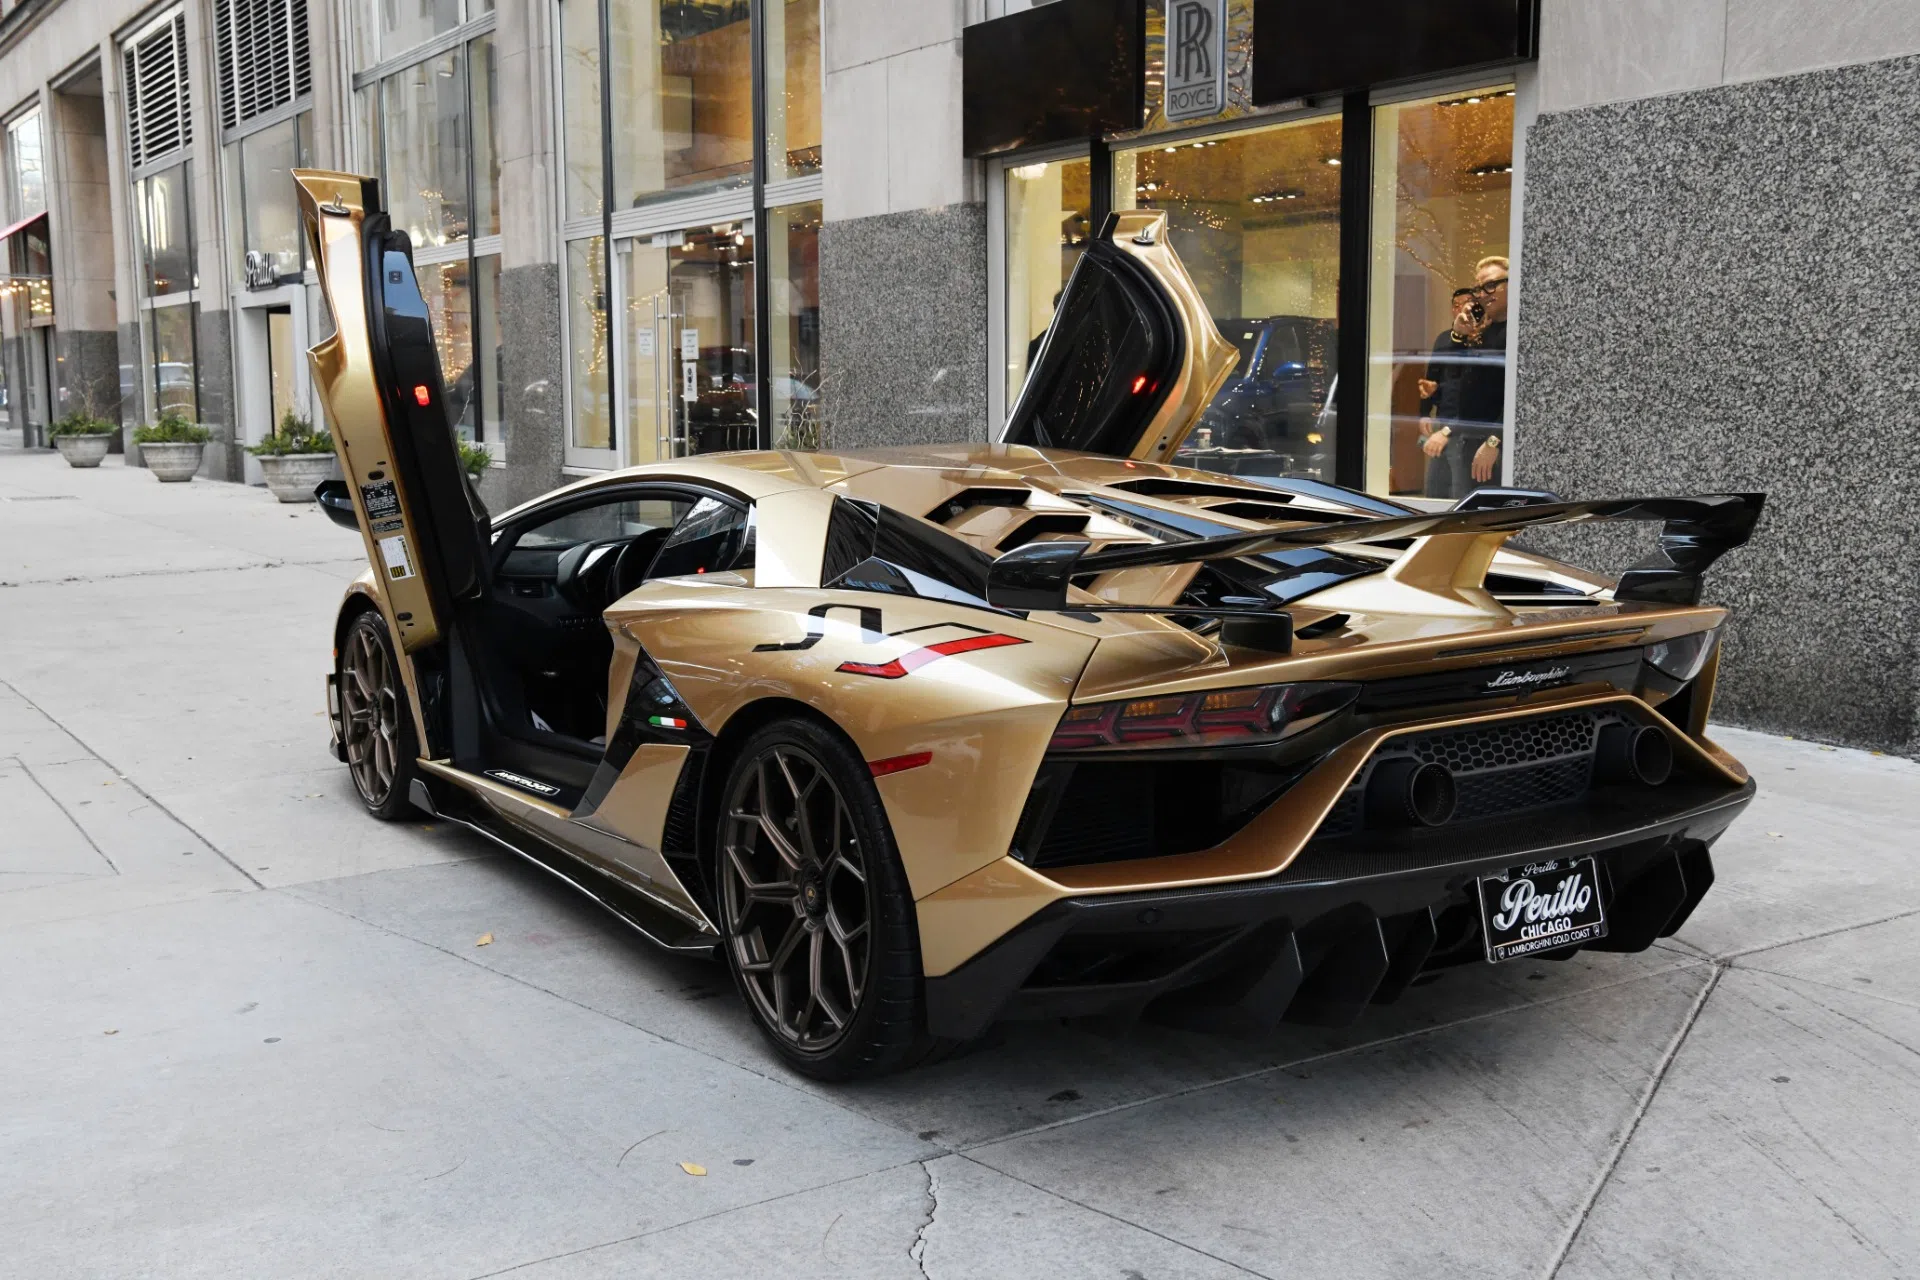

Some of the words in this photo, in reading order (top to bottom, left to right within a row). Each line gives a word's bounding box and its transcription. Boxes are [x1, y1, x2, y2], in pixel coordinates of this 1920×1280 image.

[1170, 87, 1213, 110] ROYCE
[1521, 860, 1558, 877] Perillo
[1492, 873, 1591, 931] Perillo
[1520, 917, 1572, 940] CHICAGO
[1507, 936, 1552, 957] LAMBORGHINI
[1552, 932, 1570, 945] GOLD
[1570, 928, 1591, 941] COAST
